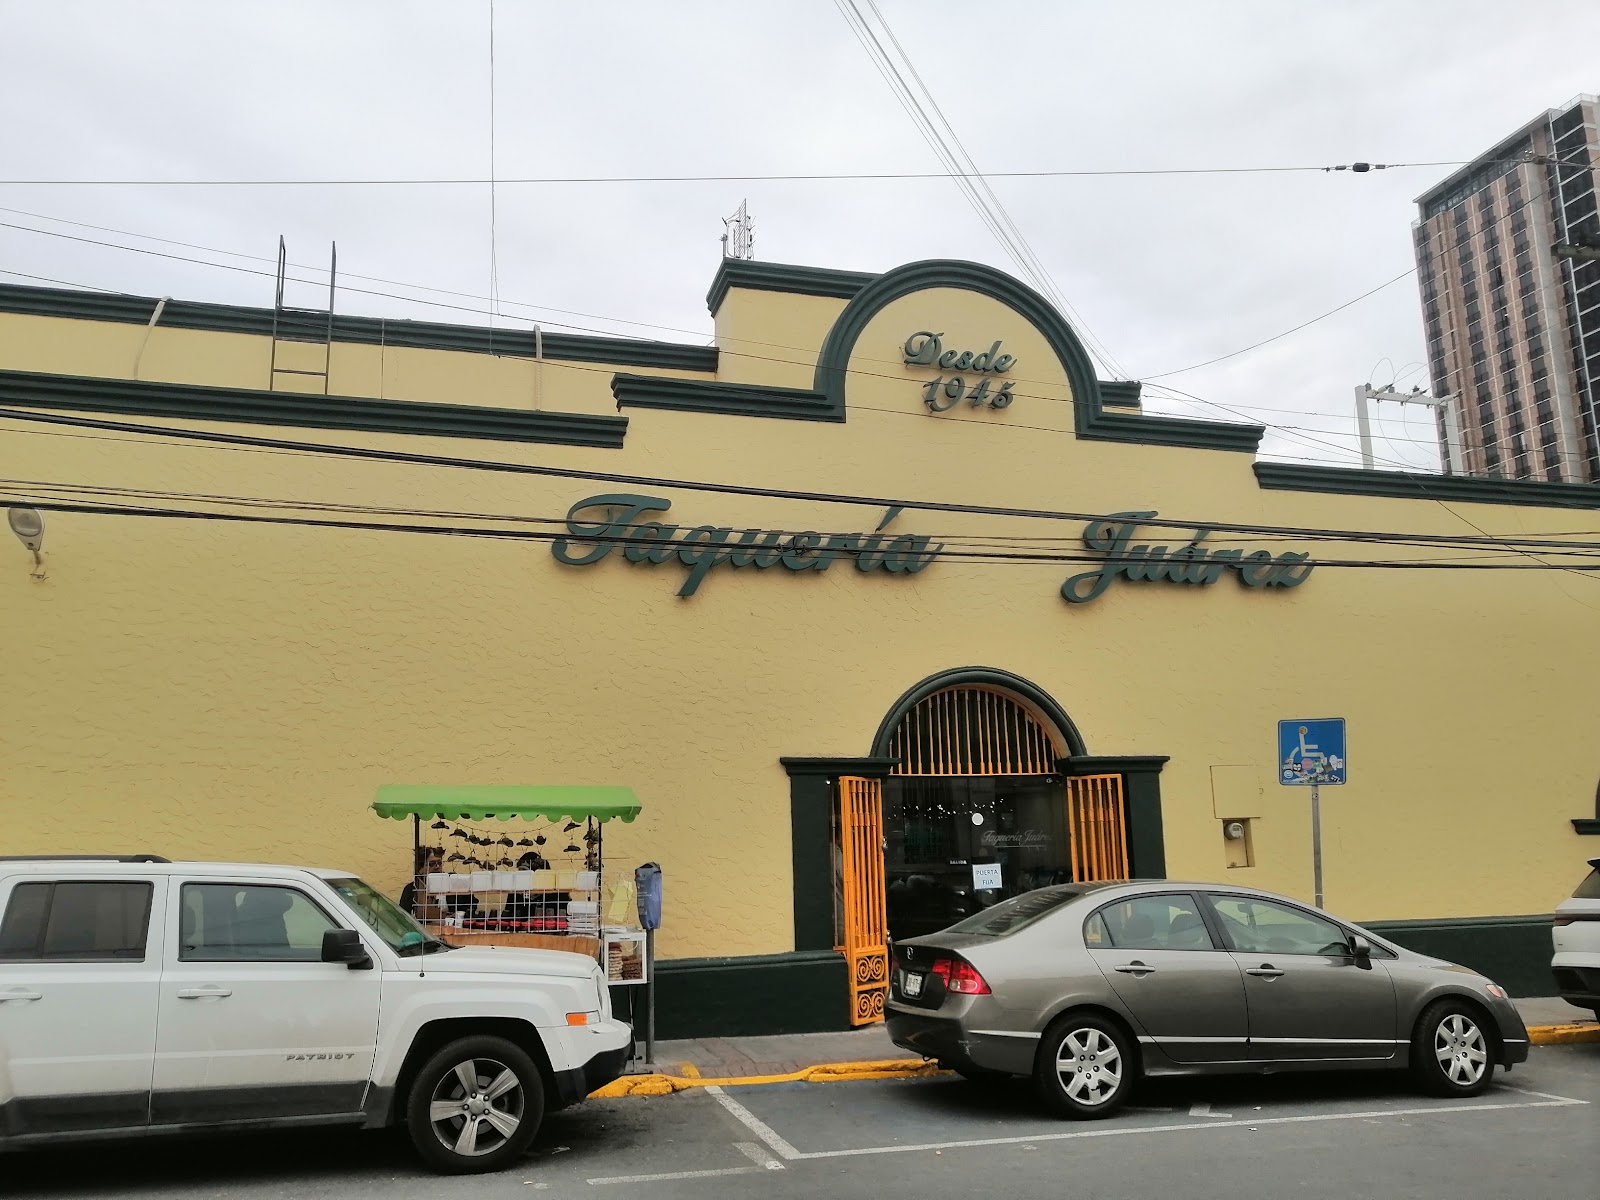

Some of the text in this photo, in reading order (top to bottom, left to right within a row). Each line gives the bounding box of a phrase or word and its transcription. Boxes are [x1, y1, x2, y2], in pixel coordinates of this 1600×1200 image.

[903, 331, 1017, 373] Desde
[922, 375, 1016, 412] 1945
[551, 493, 1316, 603] Taquería Juárez
[286, 1053, 355, 1061] PATRIOT
